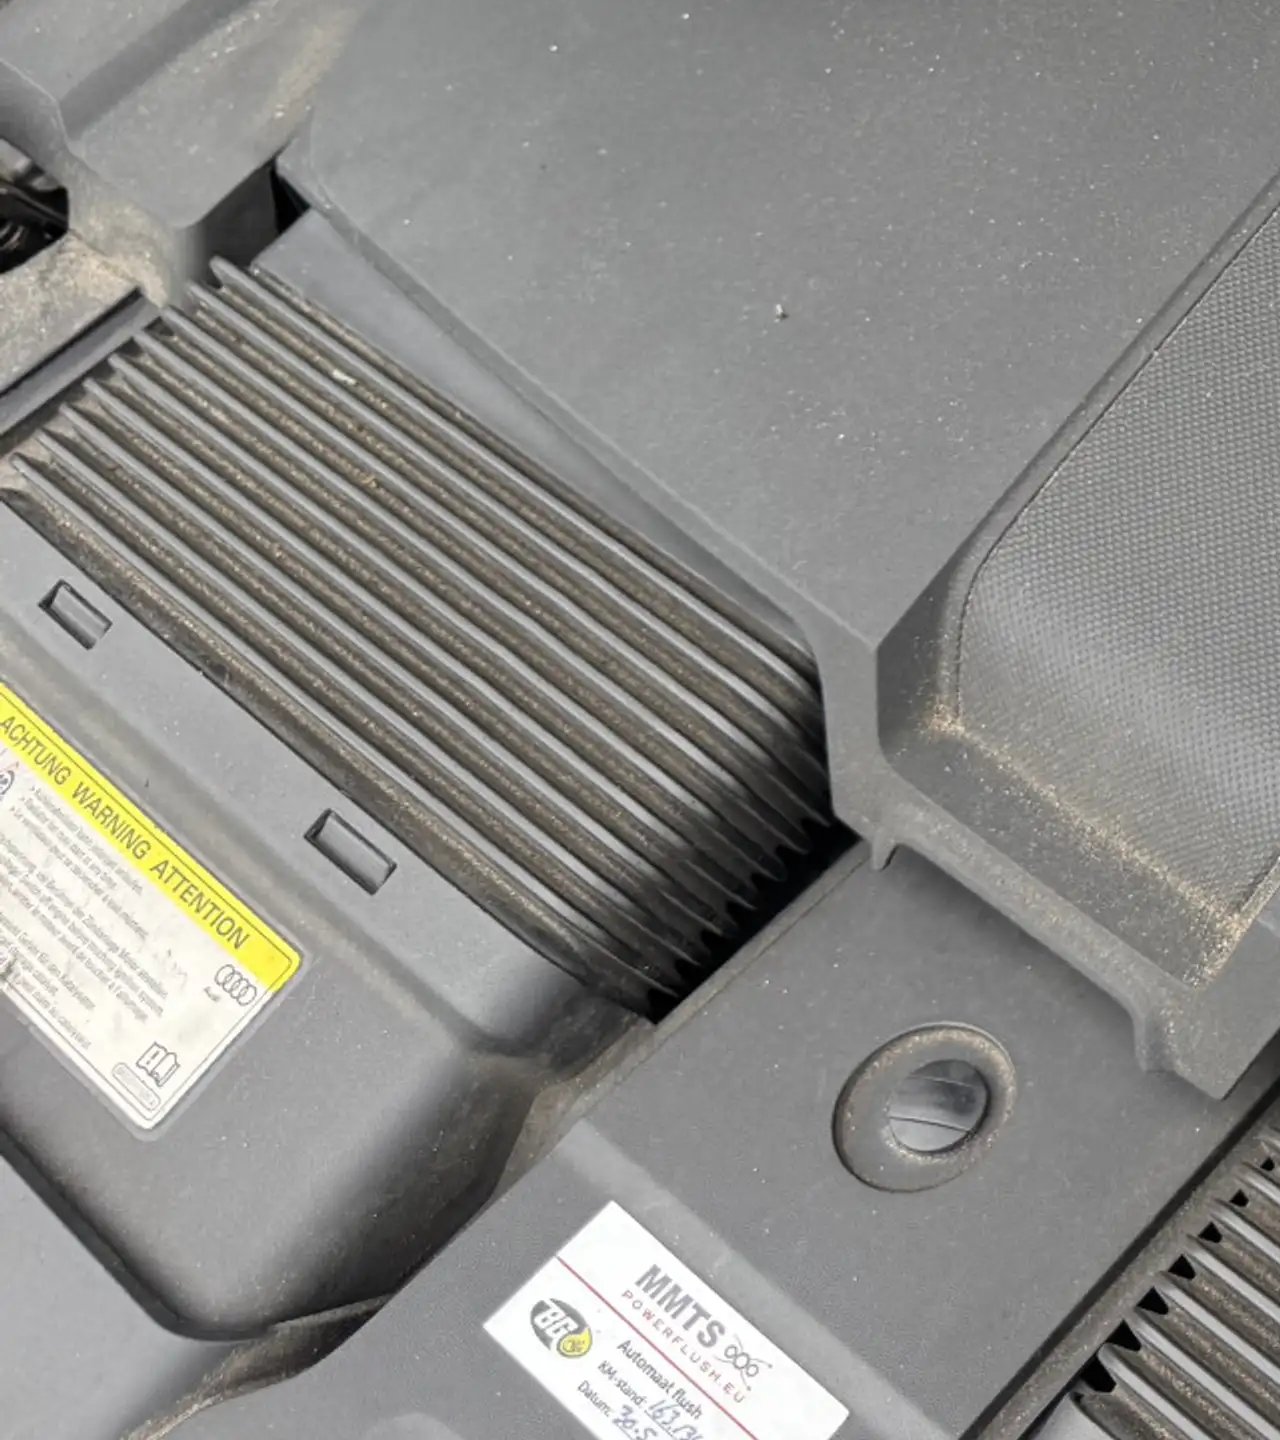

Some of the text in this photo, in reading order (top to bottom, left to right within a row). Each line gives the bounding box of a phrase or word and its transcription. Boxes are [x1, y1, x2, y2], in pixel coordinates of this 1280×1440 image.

[1, 716, 72, 786] ACHTUNG
[71, 781, 152, 861] WARNING
[150, 859, 251, 950] ATTENTION
[621, 1289, 746, 1404] POWERFLUSH.EU
[634, 1263, 726, 1348] MMTS
[616, 1340, 703, 1420] Automaat flush
